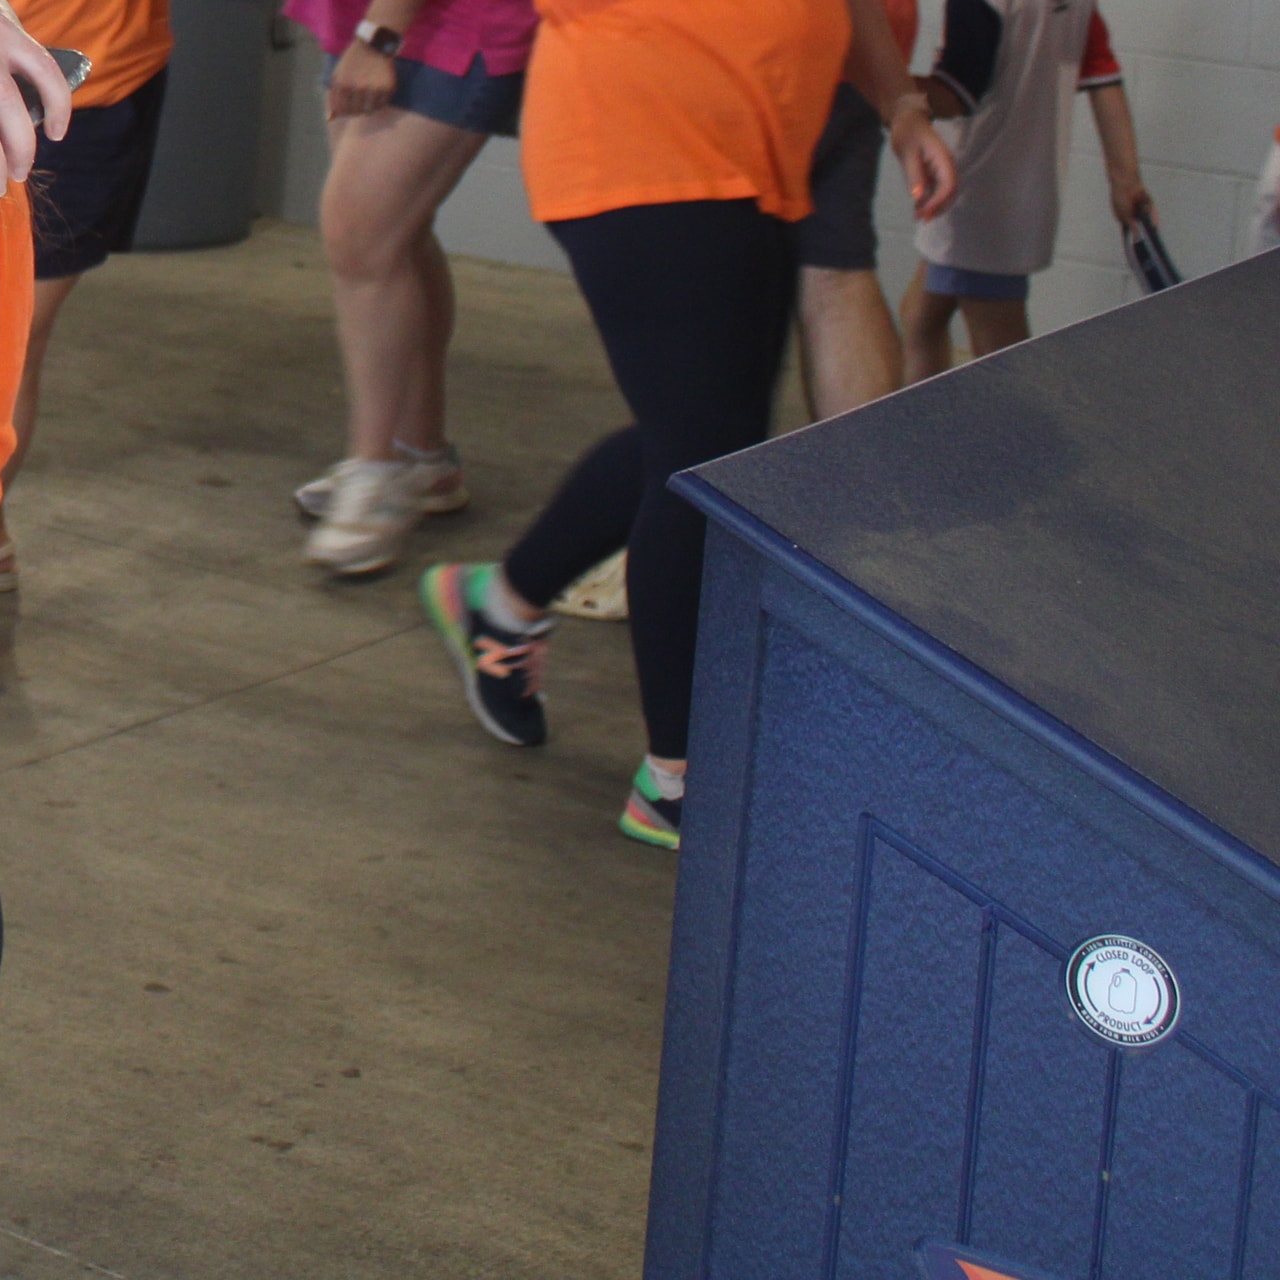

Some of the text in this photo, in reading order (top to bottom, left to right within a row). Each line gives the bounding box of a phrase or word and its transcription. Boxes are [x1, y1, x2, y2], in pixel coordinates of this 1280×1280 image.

[1095, 949, 1155, 976] CLOSED LOOP
[1097, 1011, 1142, 1033] PRODUCT
